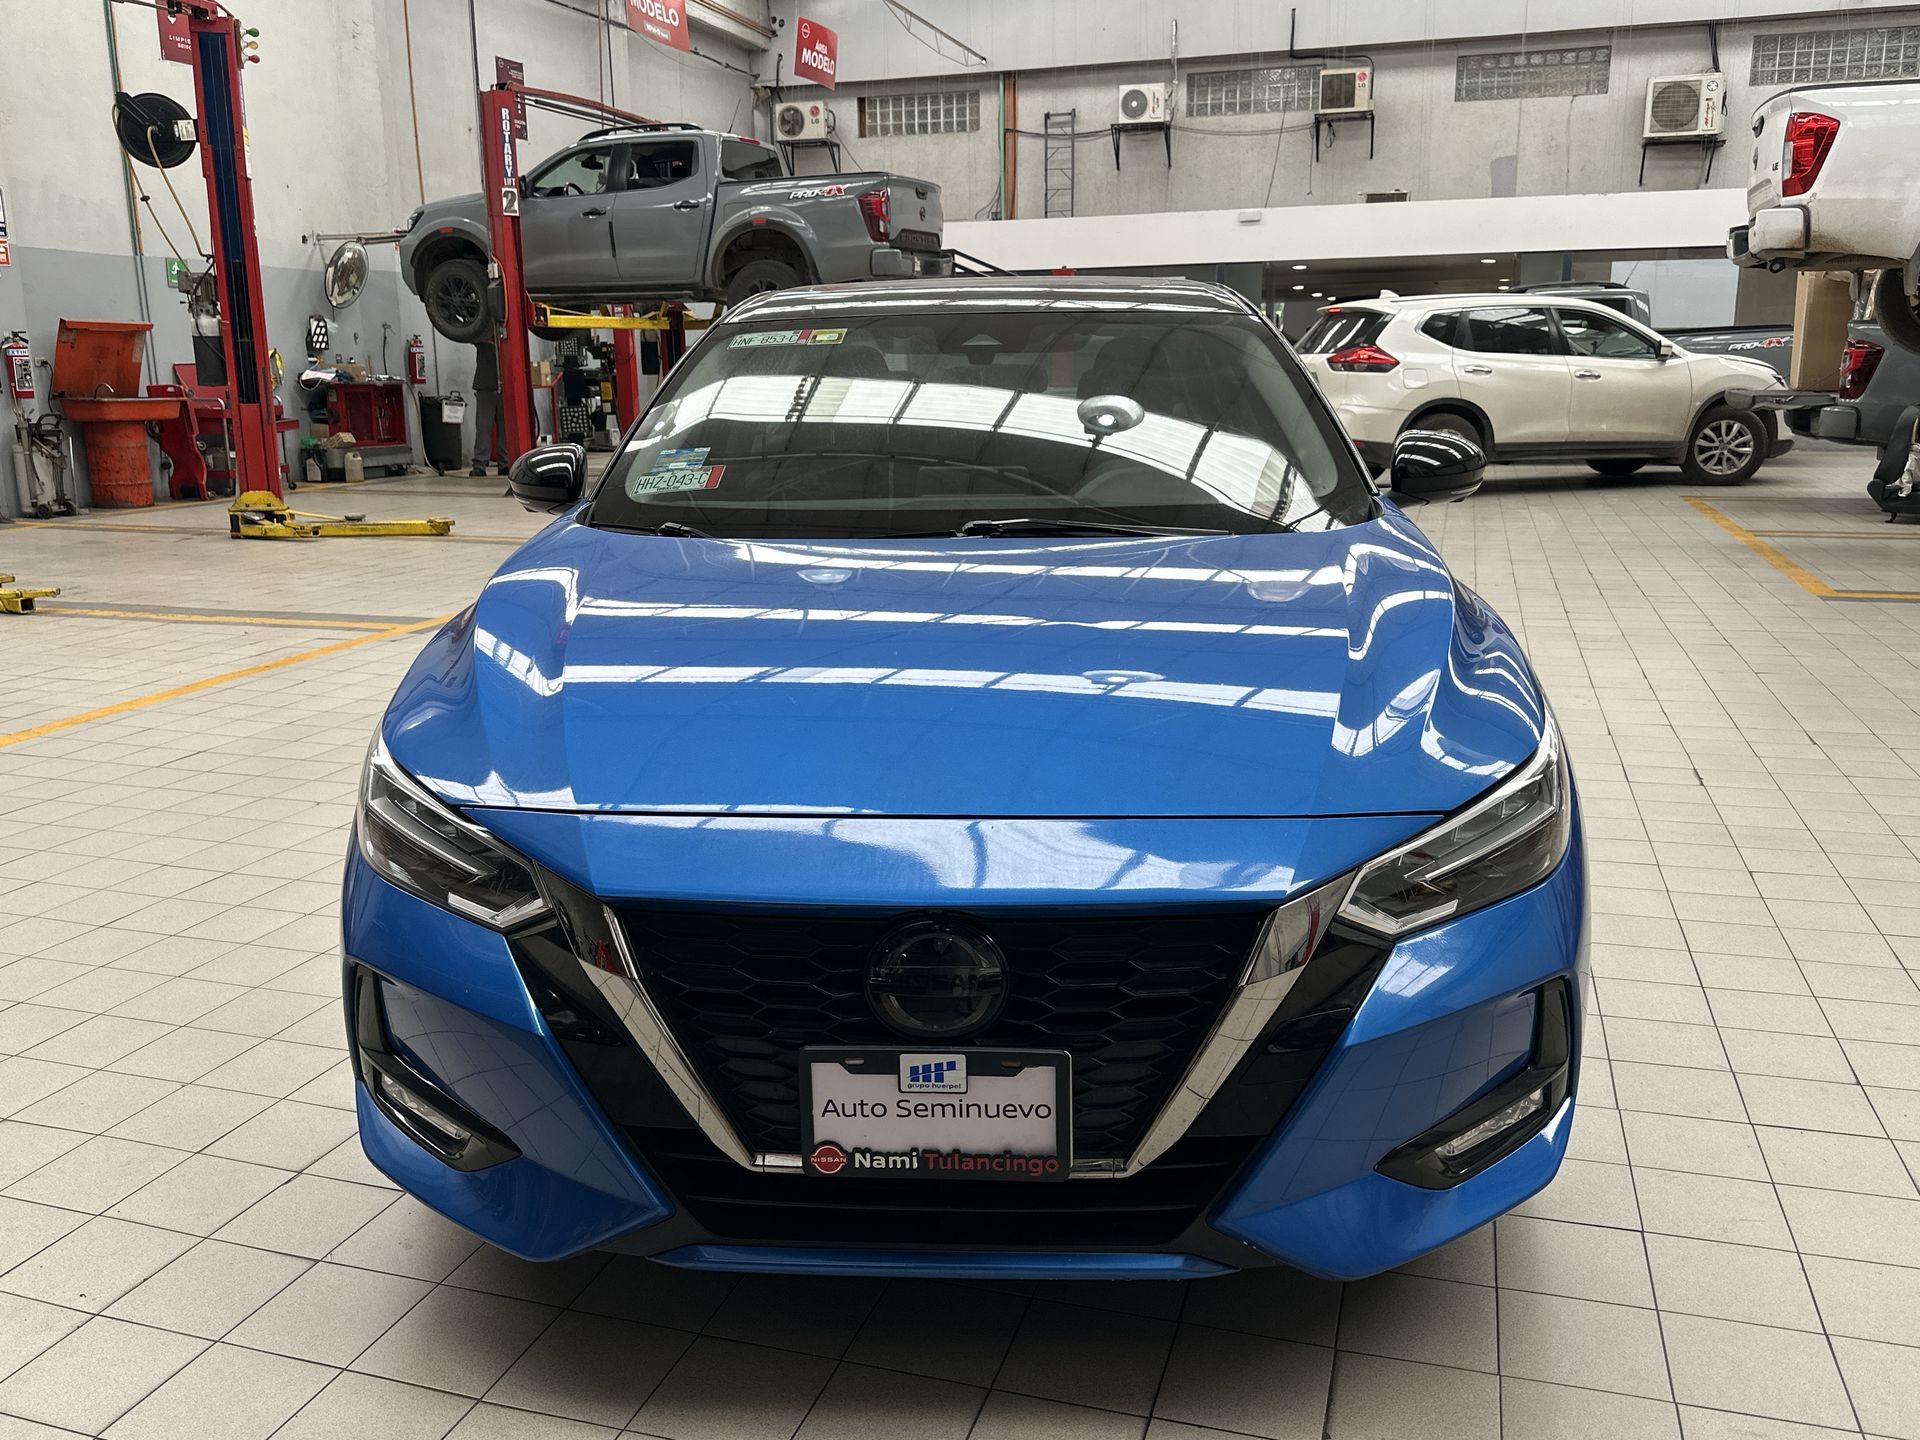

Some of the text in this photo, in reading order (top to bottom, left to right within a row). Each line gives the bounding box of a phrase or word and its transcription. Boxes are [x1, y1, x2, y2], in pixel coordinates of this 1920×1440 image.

[801, 48, 835, 75] MODELO
[501, 107, 514, 177] ROTARY
[504, 177, 516, 186] LIFT
[503, 190, 517, 214] 2
[635, 472, 709, 491] HHZ-043-C
[821, 1099, 1052, 1119] Auto Seminuevo
[854, 1151, 1060, 1177] Nami Tulancingo
